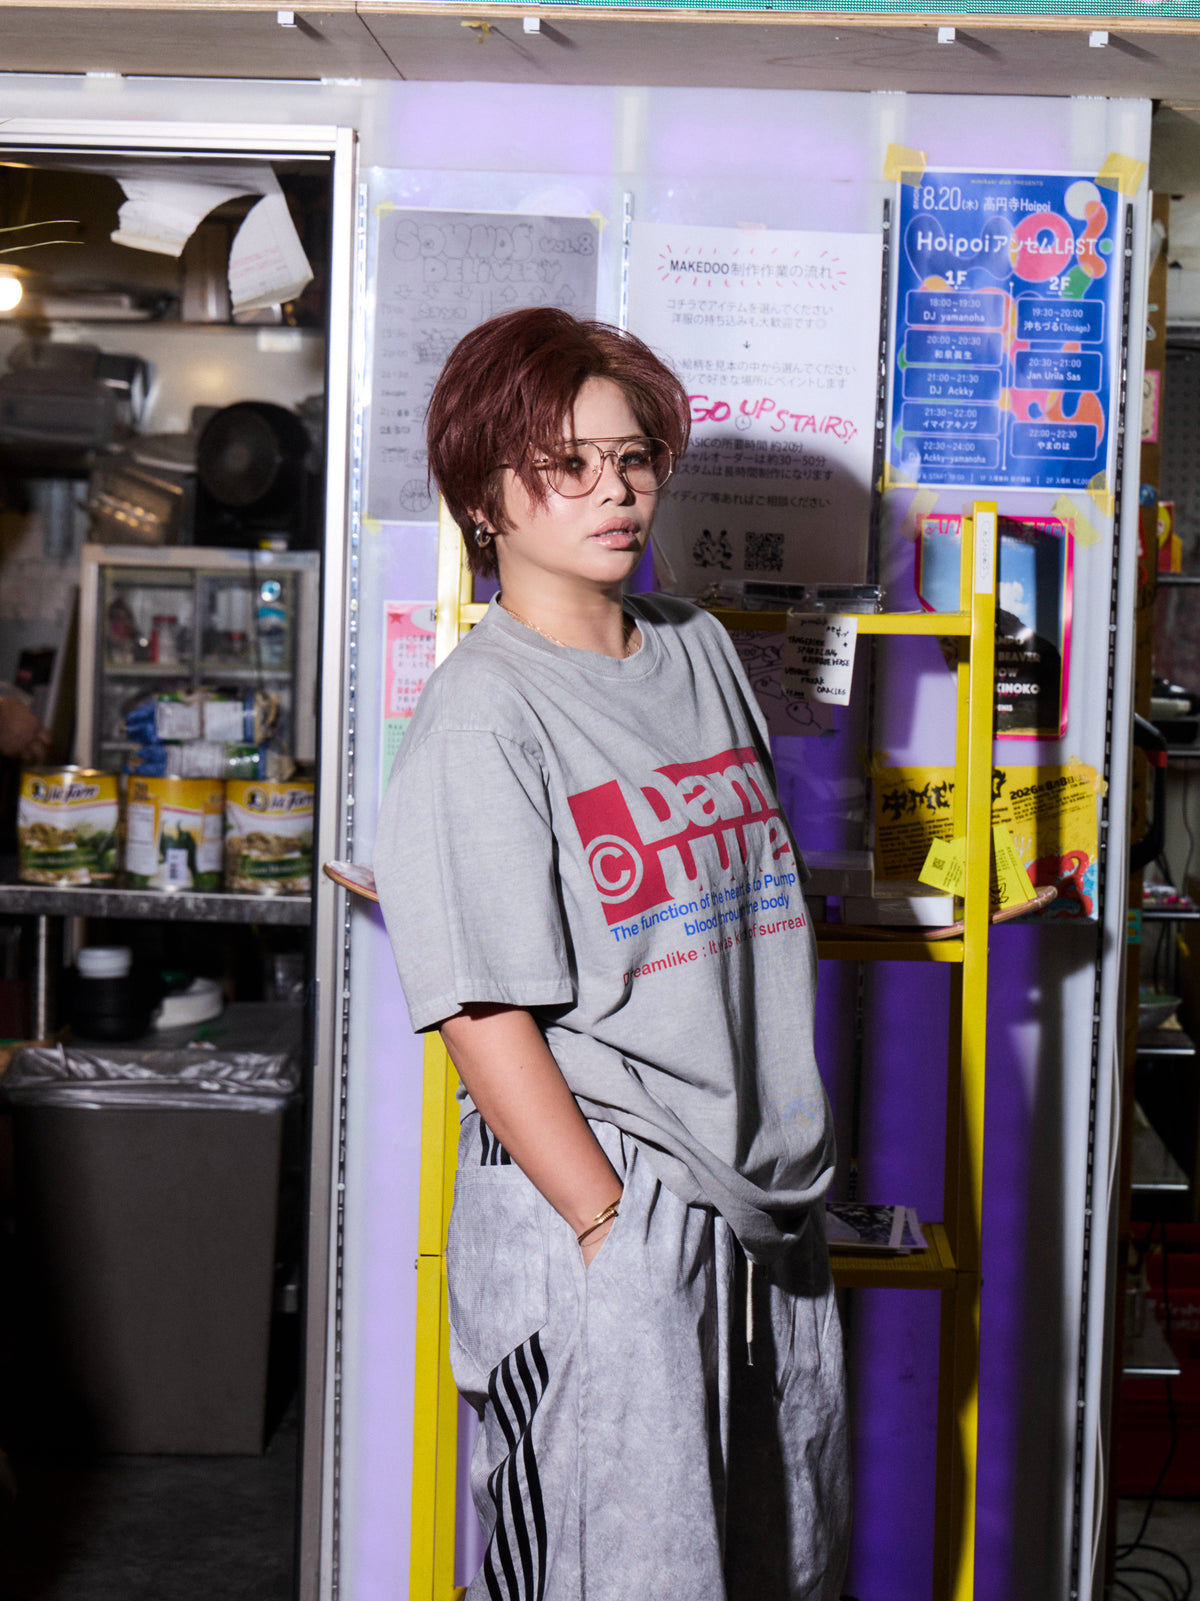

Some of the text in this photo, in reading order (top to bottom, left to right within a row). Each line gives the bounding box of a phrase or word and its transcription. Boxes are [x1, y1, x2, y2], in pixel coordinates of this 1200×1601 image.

[917, 230, 1097, 256] HoipoiアンセムLAST
[945, 270, 967, 285] 1F
[1050, 275, 1071, 291] 2F
[923, 311, 936, 321] DJ
[929, 385, 974, 398] DJ Ackky
[610, 924, 639, 942] The
[640, 901, 699, 931] function
[700, 893, 710, 910] of
[753, 878, 762, 891] to
[764, 872, 796, 889] Pump
[684, 913, 718, 936] blood
[760, 893, 790, 910] body
[708, 940, 718, 955] It
[759, 913, 807, 936] surreal
